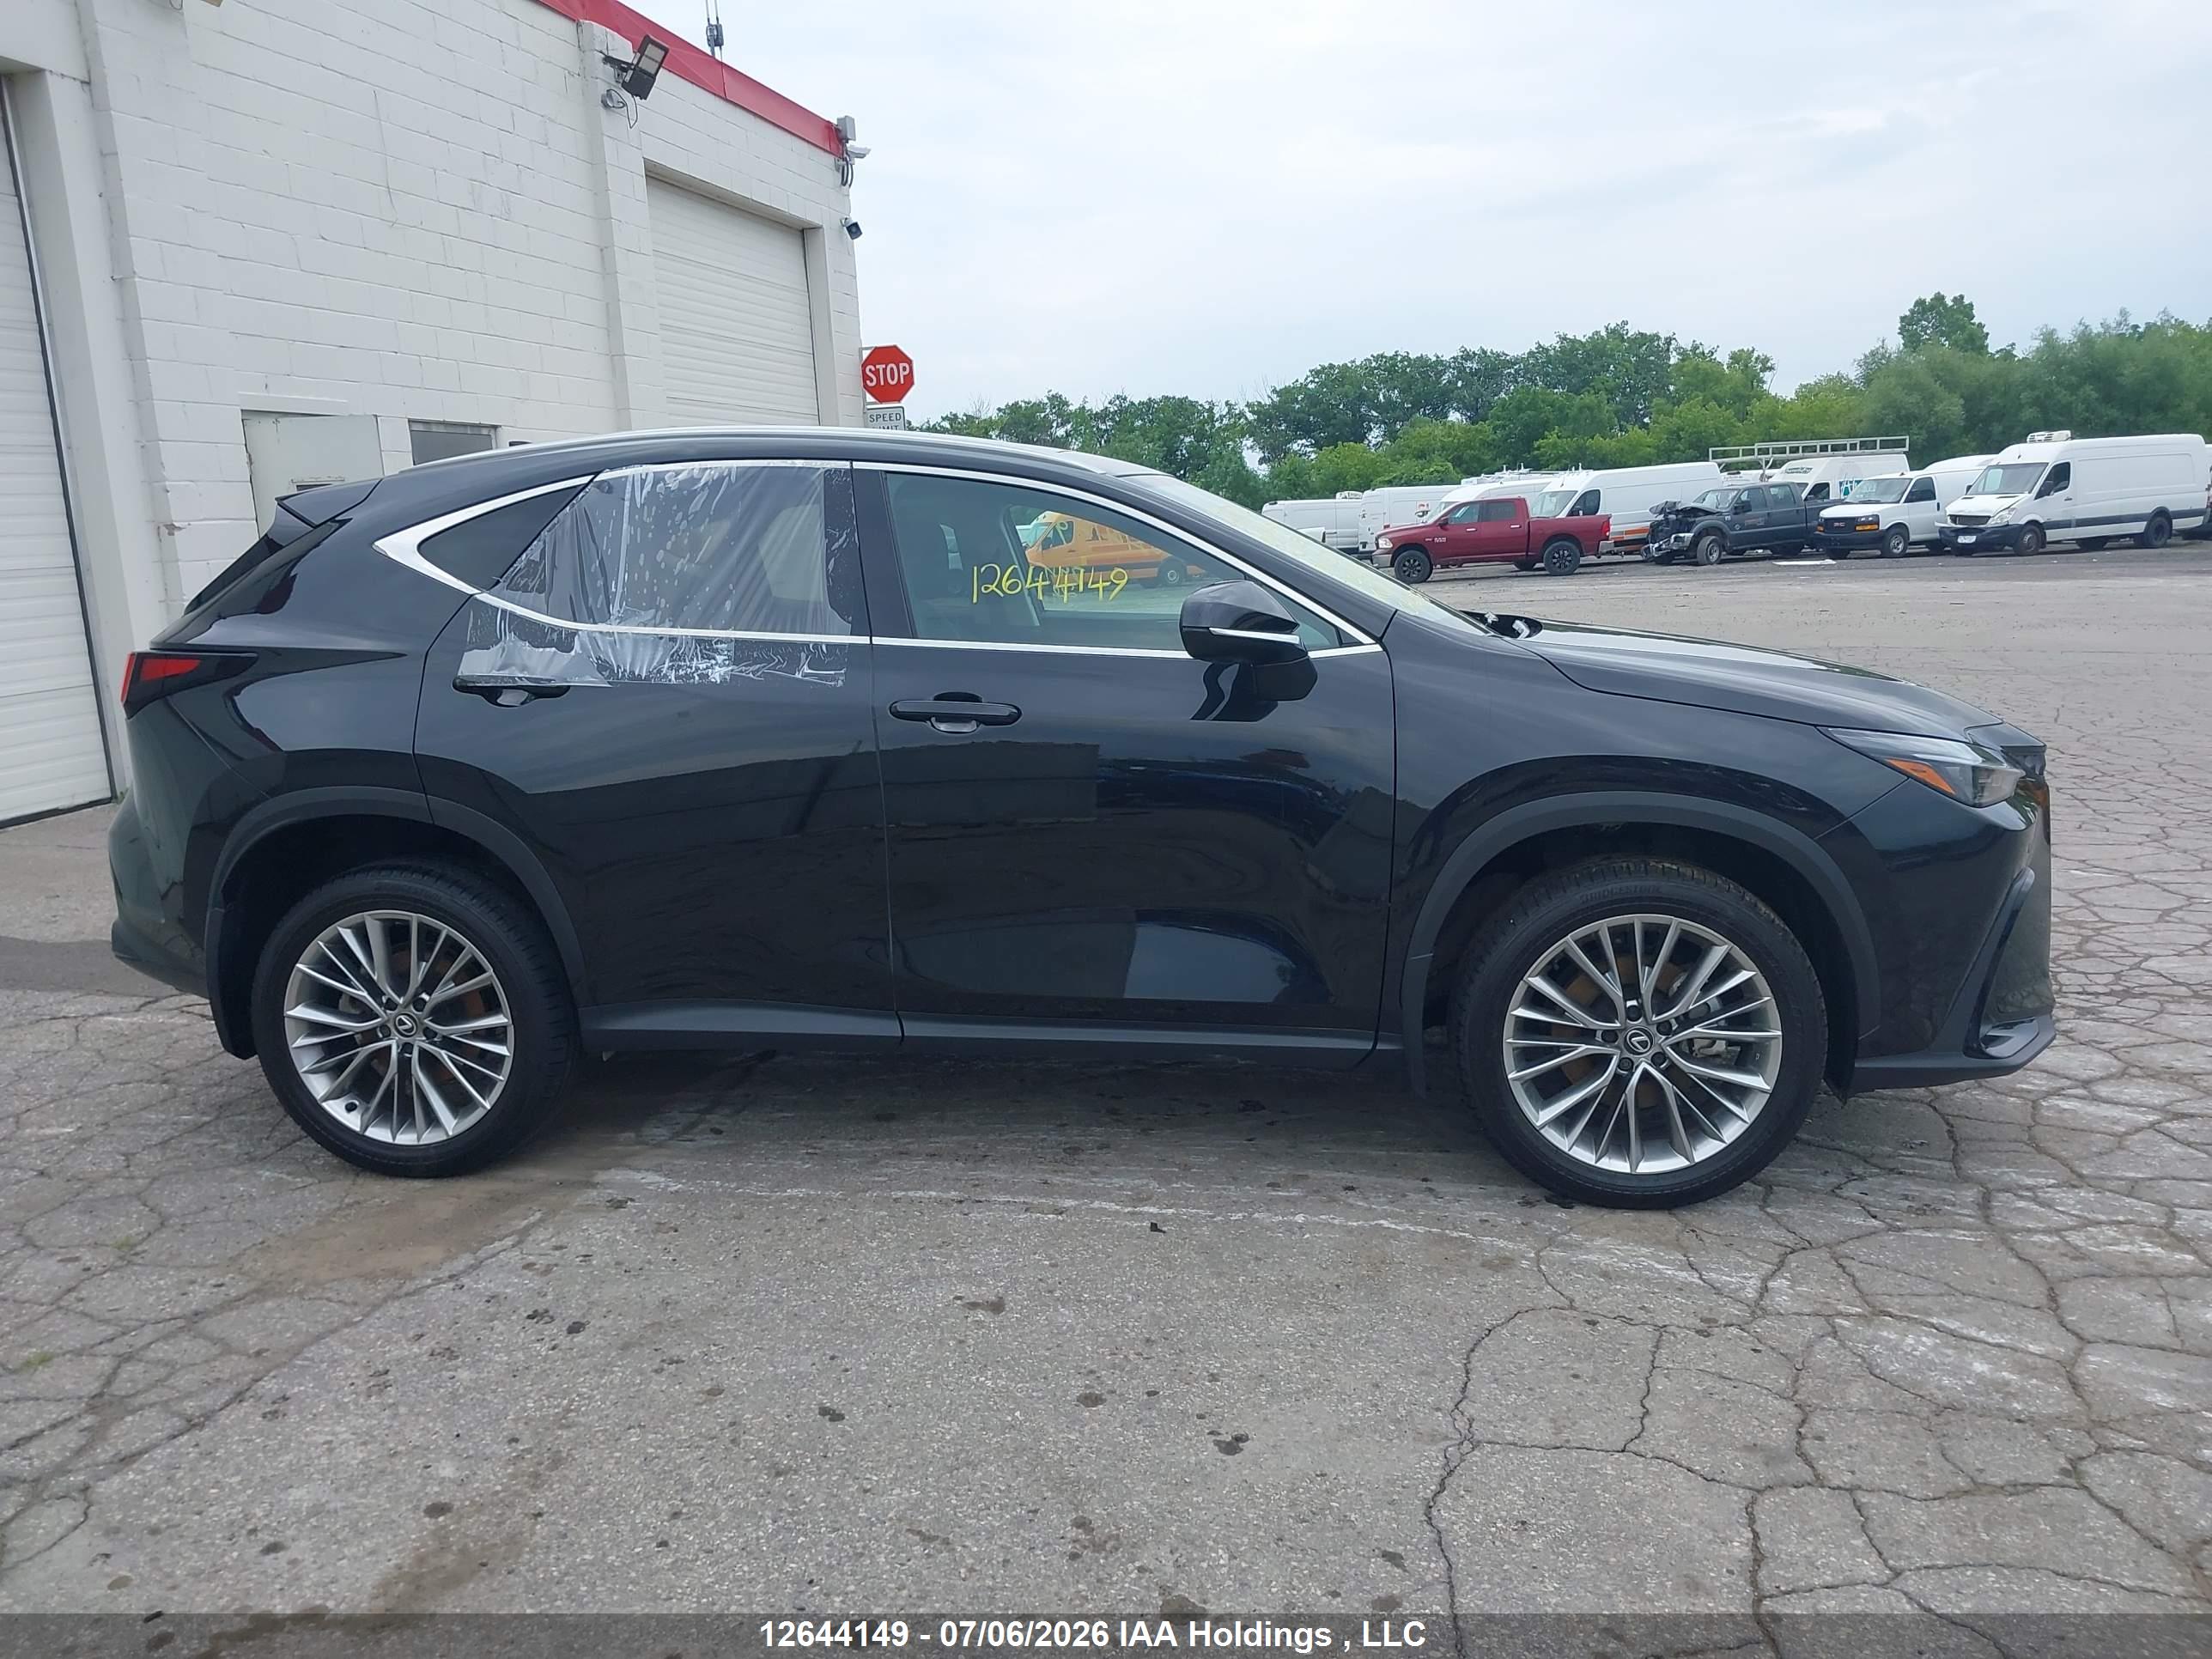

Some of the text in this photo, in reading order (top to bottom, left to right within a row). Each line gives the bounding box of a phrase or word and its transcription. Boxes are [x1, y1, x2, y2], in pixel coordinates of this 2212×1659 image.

[865, 362, 910, 386] STOP
[869, 412, 902, 423] SPEED
[972, 562, 1128, 604] 12644149
